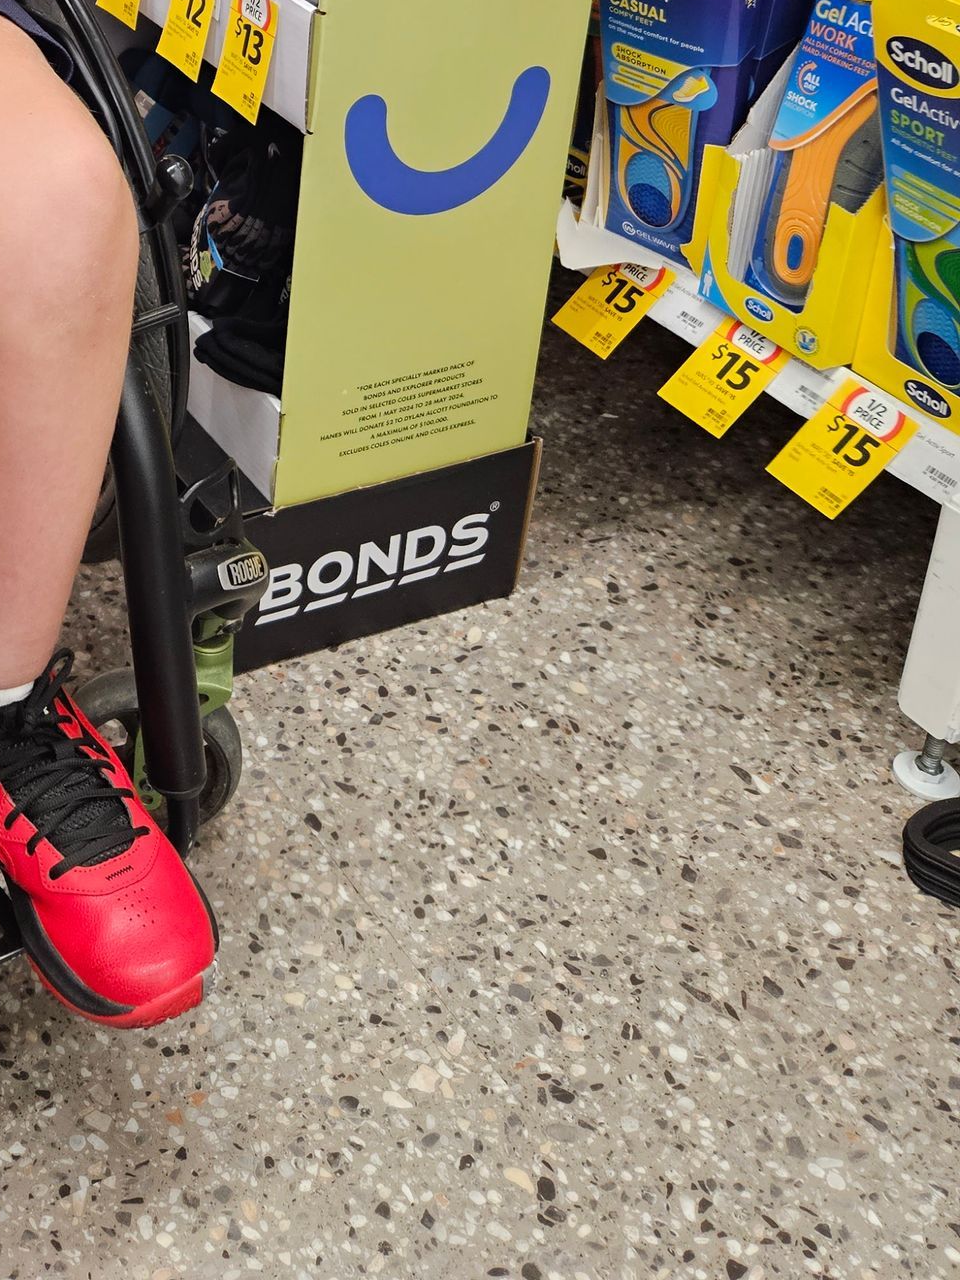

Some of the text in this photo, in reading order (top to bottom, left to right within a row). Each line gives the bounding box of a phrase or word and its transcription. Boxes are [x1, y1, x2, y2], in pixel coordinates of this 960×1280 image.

[245, 4, 262, 22] PRICE
[609, 7, 653, 27] COMFY FEET
[235, 16, 264, 66] $13
[608, 17, 704, 53] Customised comfort for people
[616, 26, 627, 35] the
[627, 31, 644, 41] move
[810, 20, 858, 51] WORK
[616, 45, 642, 60] SHOCK
[802, 44, 870, 77] HARD-WORKING FEET
[805, 36, 861, 64] ALL DAY COMFORT
[890, 40, 953, 84] Scholl
[616, 53, 667, 75] ABSORPTION
[804, 72, 821, 87] ALL
[787, 91, 819, 111] SHOCK
[891, 109, 945, 146] SPORT
[636, 230, 676, 252] GELWAVE
[624, 263, 648, 282] PRICE
[602, 270, 645, 313] $15
[747, 300, 771, 320] Scholl
[738, 334, 765, 355] PRICE
[374, 380, 390, 388] EACH
[391, 372, 421, 384] SPECIALLY
[423, 366, 448, 377] MARKED
[450, 362, 465, 370] PACK
[712, 343, 760, 391] $15
[868, 398, 888, 417] 1/2
[906, 381, 948, 416] Scholl
[854, 406, 885, 430] PRICE
[827, 414, 881, 467] $15
[232, 558, 265, 586] ROGUE
[258, 513, 490, 612] BONDS
